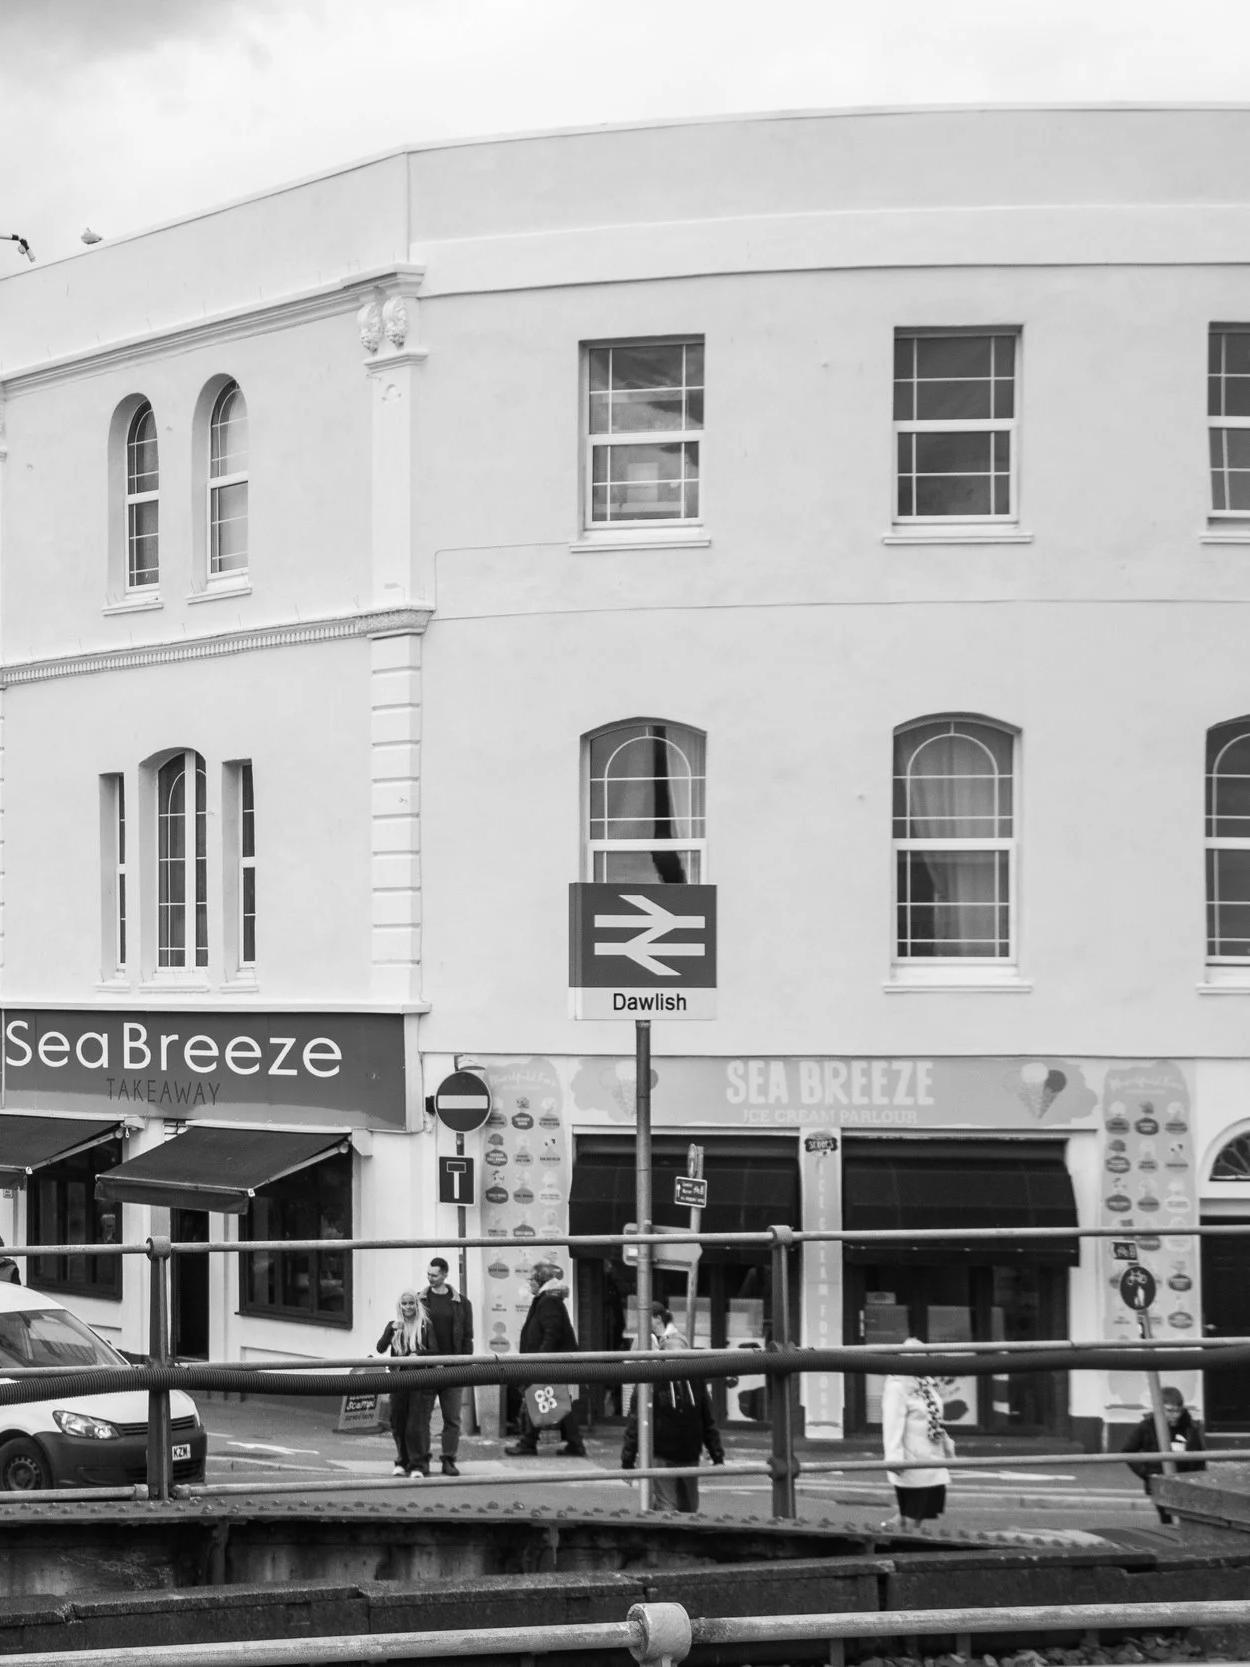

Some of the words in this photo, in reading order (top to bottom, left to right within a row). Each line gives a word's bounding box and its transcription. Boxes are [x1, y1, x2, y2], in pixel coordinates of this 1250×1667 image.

[613, 994, 687, 1011] Dawlish
[5, 1020, 111, 1070] Sea
[123, 1022, 343, 1078] Breeze
[106, 1077, 221, 1106] TAKEAWAY
[726, 1060, 789, 1105] SEA
[799, 1060, 935, 1106] BREEZE
[742, 1109, 770, 1123] ICE
[774, 1109, 836, 1124] CREAM
[839, 1109, 918, 1124] PARLOUR
